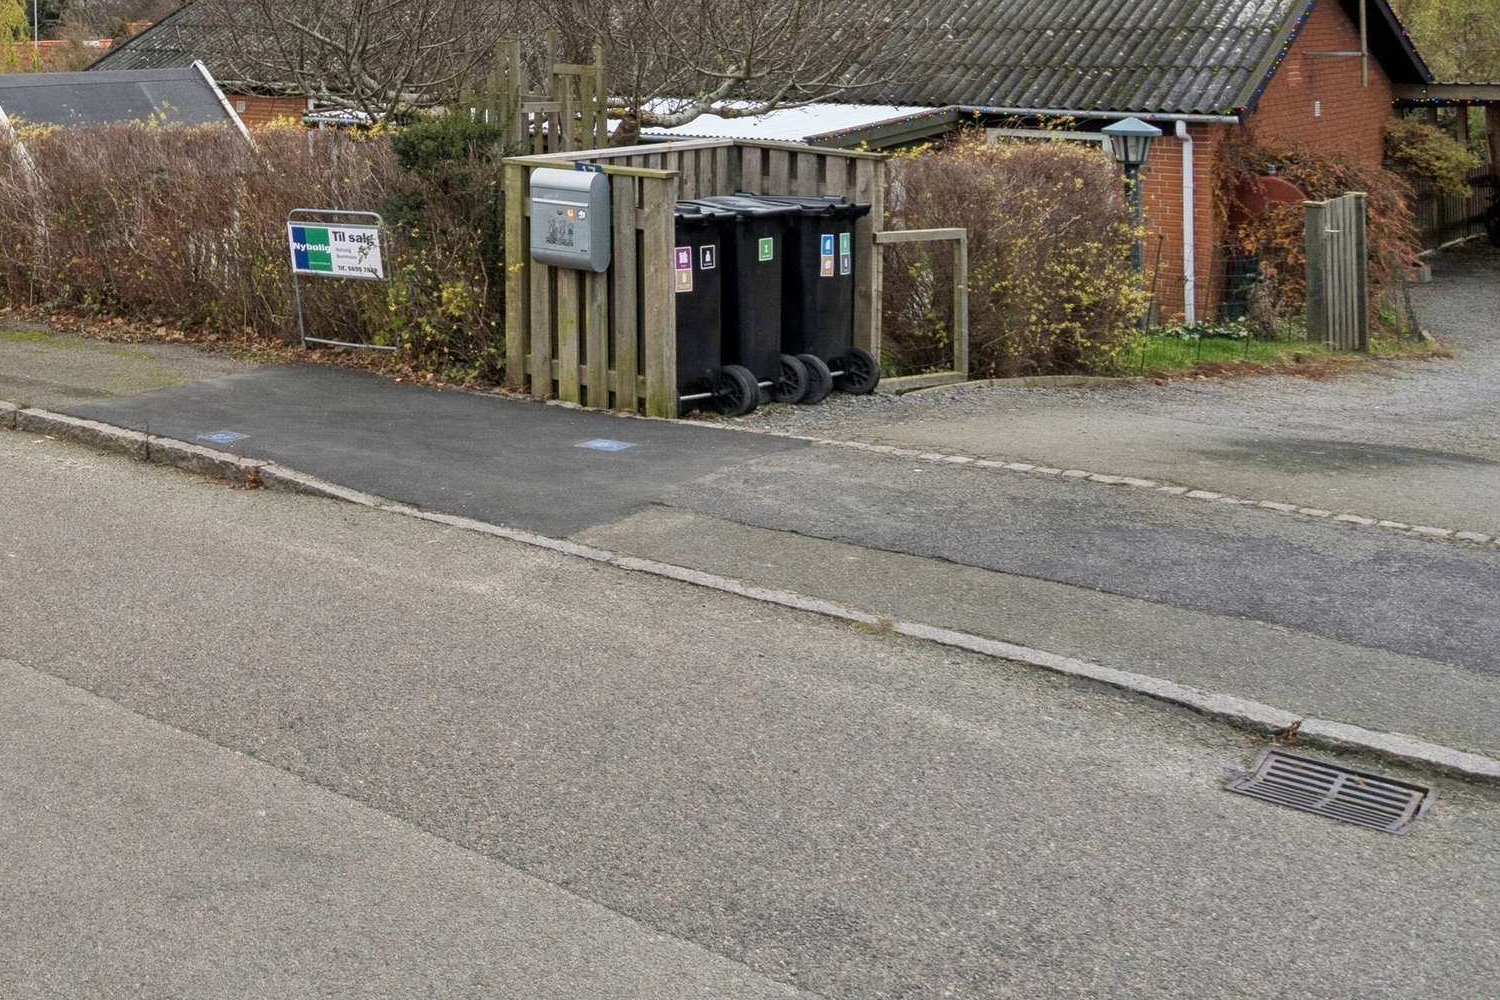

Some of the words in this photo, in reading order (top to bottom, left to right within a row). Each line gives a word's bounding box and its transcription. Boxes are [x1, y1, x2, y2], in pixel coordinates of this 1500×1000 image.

[332, 231, 346, 242] Til
[348, 233, 375, 247] salg
[293, 242, 331, 254] Nybolig
